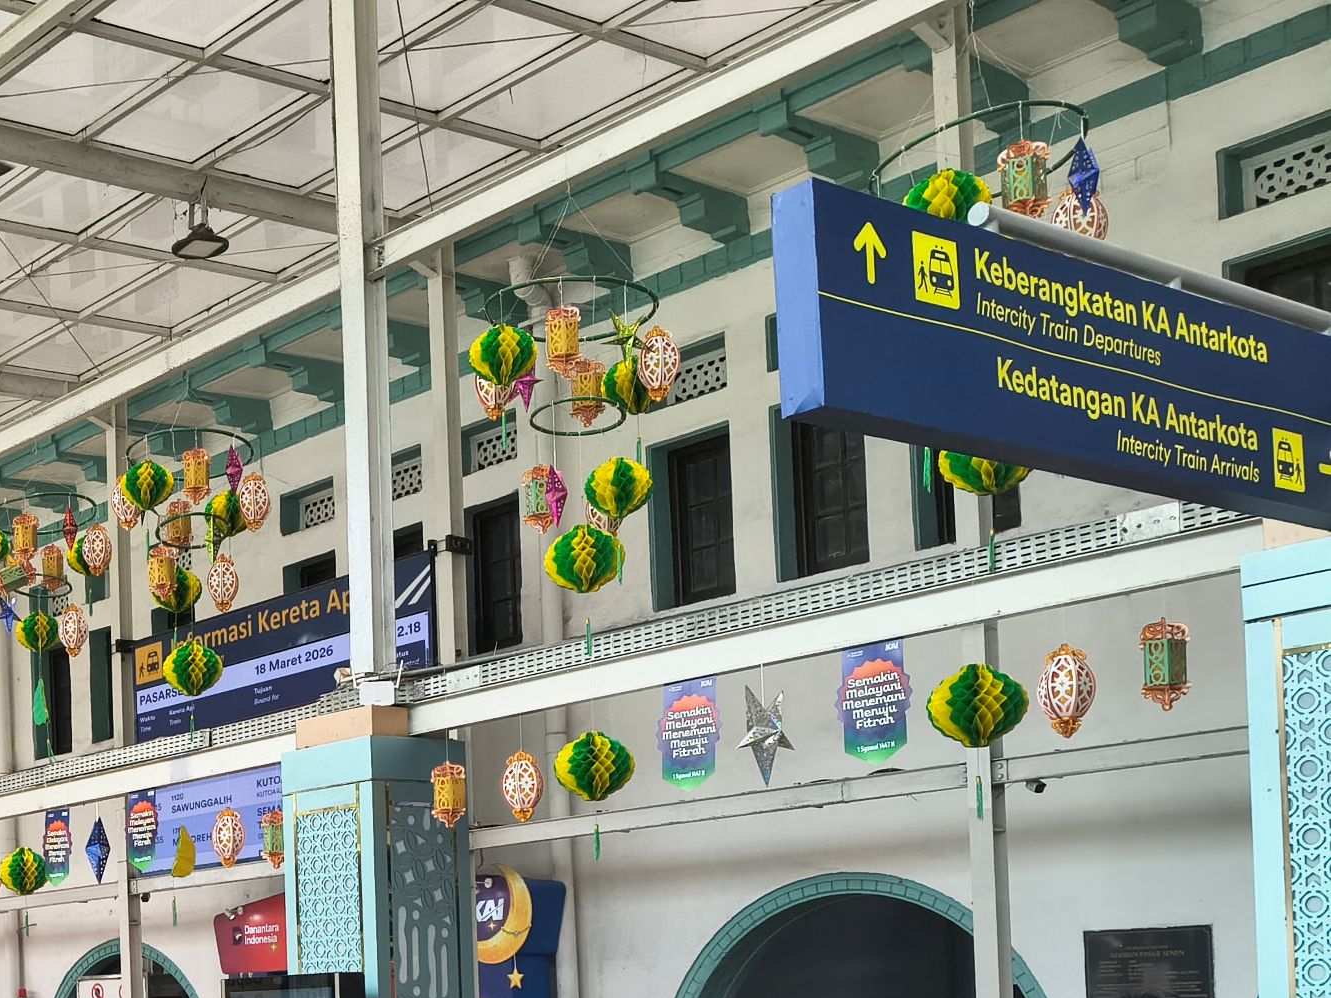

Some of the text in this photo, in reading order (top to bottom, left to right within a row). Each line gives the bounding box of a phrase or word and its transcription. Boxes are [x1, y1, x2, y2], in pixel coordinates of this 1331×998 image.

[974, 247, 1268, 363] Keberangkatan KA Antarkota
[976, 292, 1161, 366] Intercity Train Departures
[997, 356, 1258, 451] Kedatangan KA Antarkota
[1117, 430, 1260, 483] Intercity Train Arrivals
[258, 599, 320, 633] Kereta
[254, 621, 421, 675] 18 Maret 2026 2.18
[847, 671, 900, 688] Semakin
[254, 685, 273, 694] Tujuan
[845, 679, 902, 700] Melayani
[842, 689, 906, 711] Menemani
[667, 705, 712, 720] Semakin
[852, 703, 897, 719] Menuju
[665, 713, 714, 730] Melayani
[856, 715, 895, 730] Fitrah
[662, 723, 717, 741] Menemani
[670, 735, 709, 749] Menuju
[672, 746, 706, 758] Fitrah
[171, 795, 233, 814] SAWUNGGALIH
[257, 775, 281, 788] KUTO
[476, 898, 504, 922] KAI
[244, 923, 280, 934] Danantara
[244, 933, 278, 945] Indonesia
